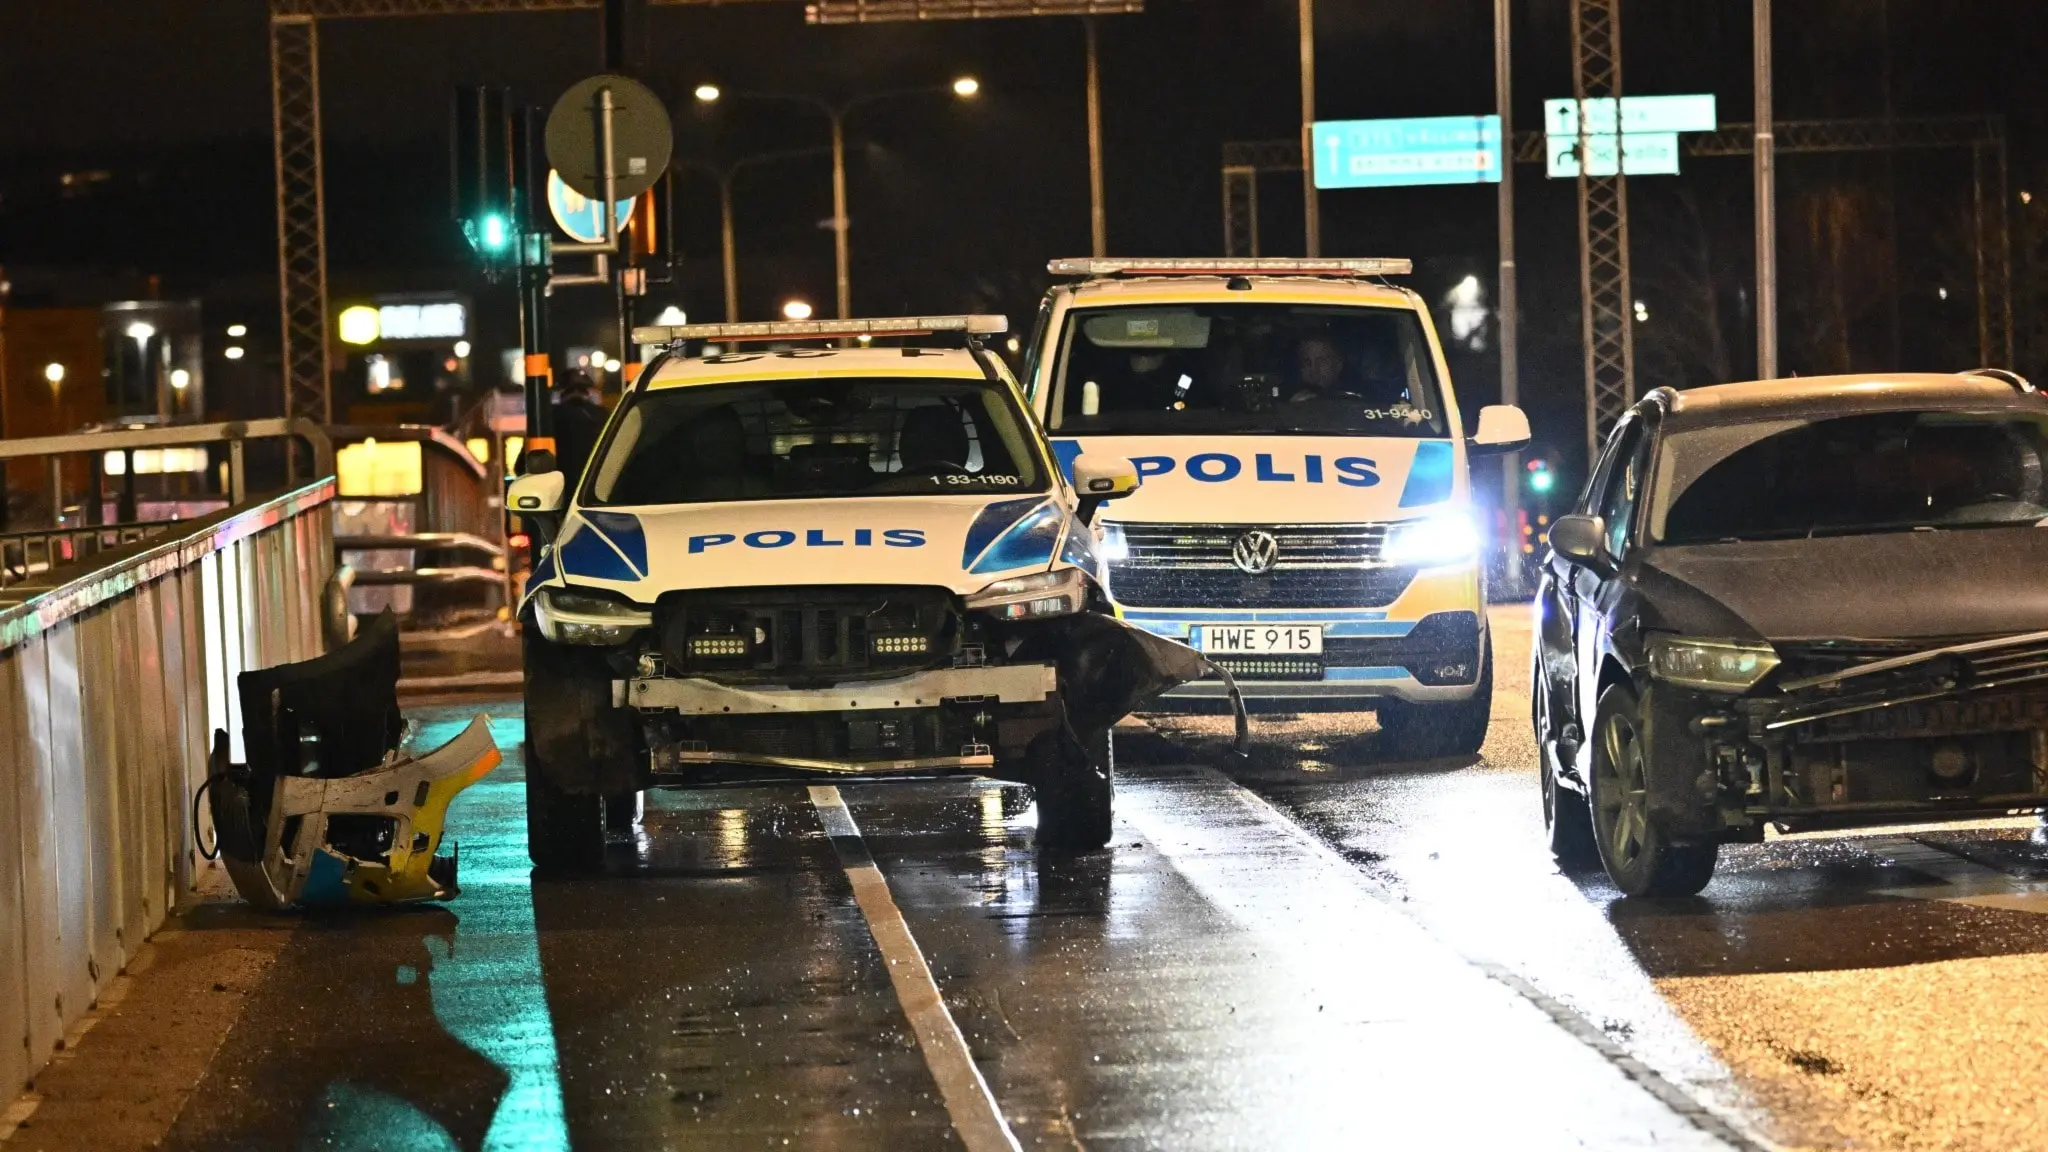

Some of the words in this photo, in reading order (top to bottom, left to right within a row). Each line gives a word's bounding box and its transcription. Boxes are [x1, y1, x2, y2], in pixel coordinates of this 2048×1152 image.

[929, 475, 941, 485] 1
[946, 474, 1018, 485] 33-1190
[1129, 453, 1381, 487] POLIS
[688, 529, 927, 554] POLIS
[1211, 629, 1256, 649] HWE
[1265, 629, 1311, 650] 915
